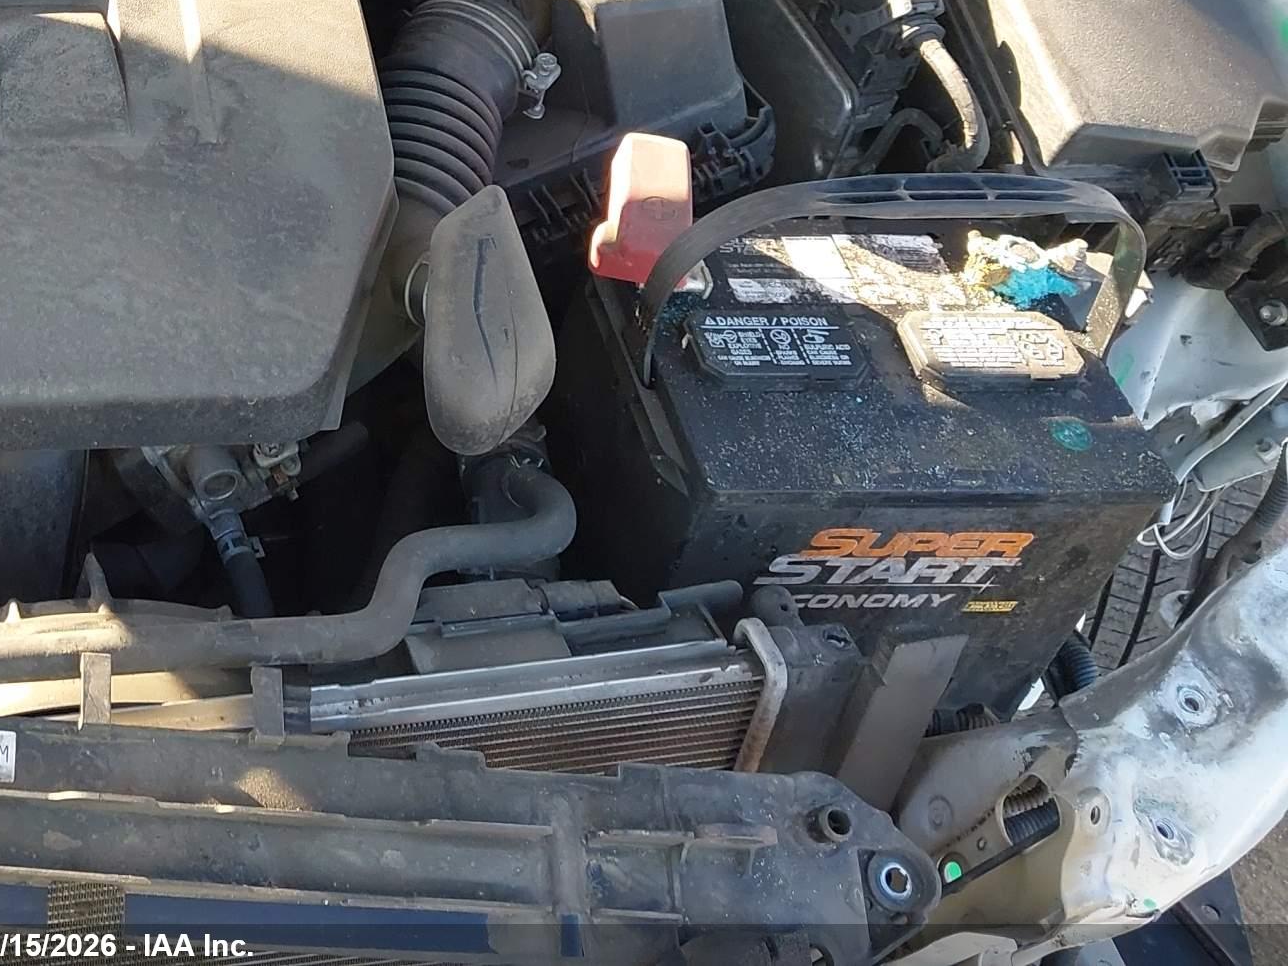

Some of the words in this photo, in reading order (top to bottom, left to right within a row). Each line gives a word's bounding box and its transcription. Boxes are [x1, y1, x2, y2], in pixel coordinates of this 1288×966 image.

[716, 316, 769, 326] DANGER
[772, 317, 777, 326] /
[780, 317, 828, 327] POISON
[799, 528, 1036, 559] SUPER
[753, 554, 1023, 585] START
[792, 593, 957, 609] CONOMY
